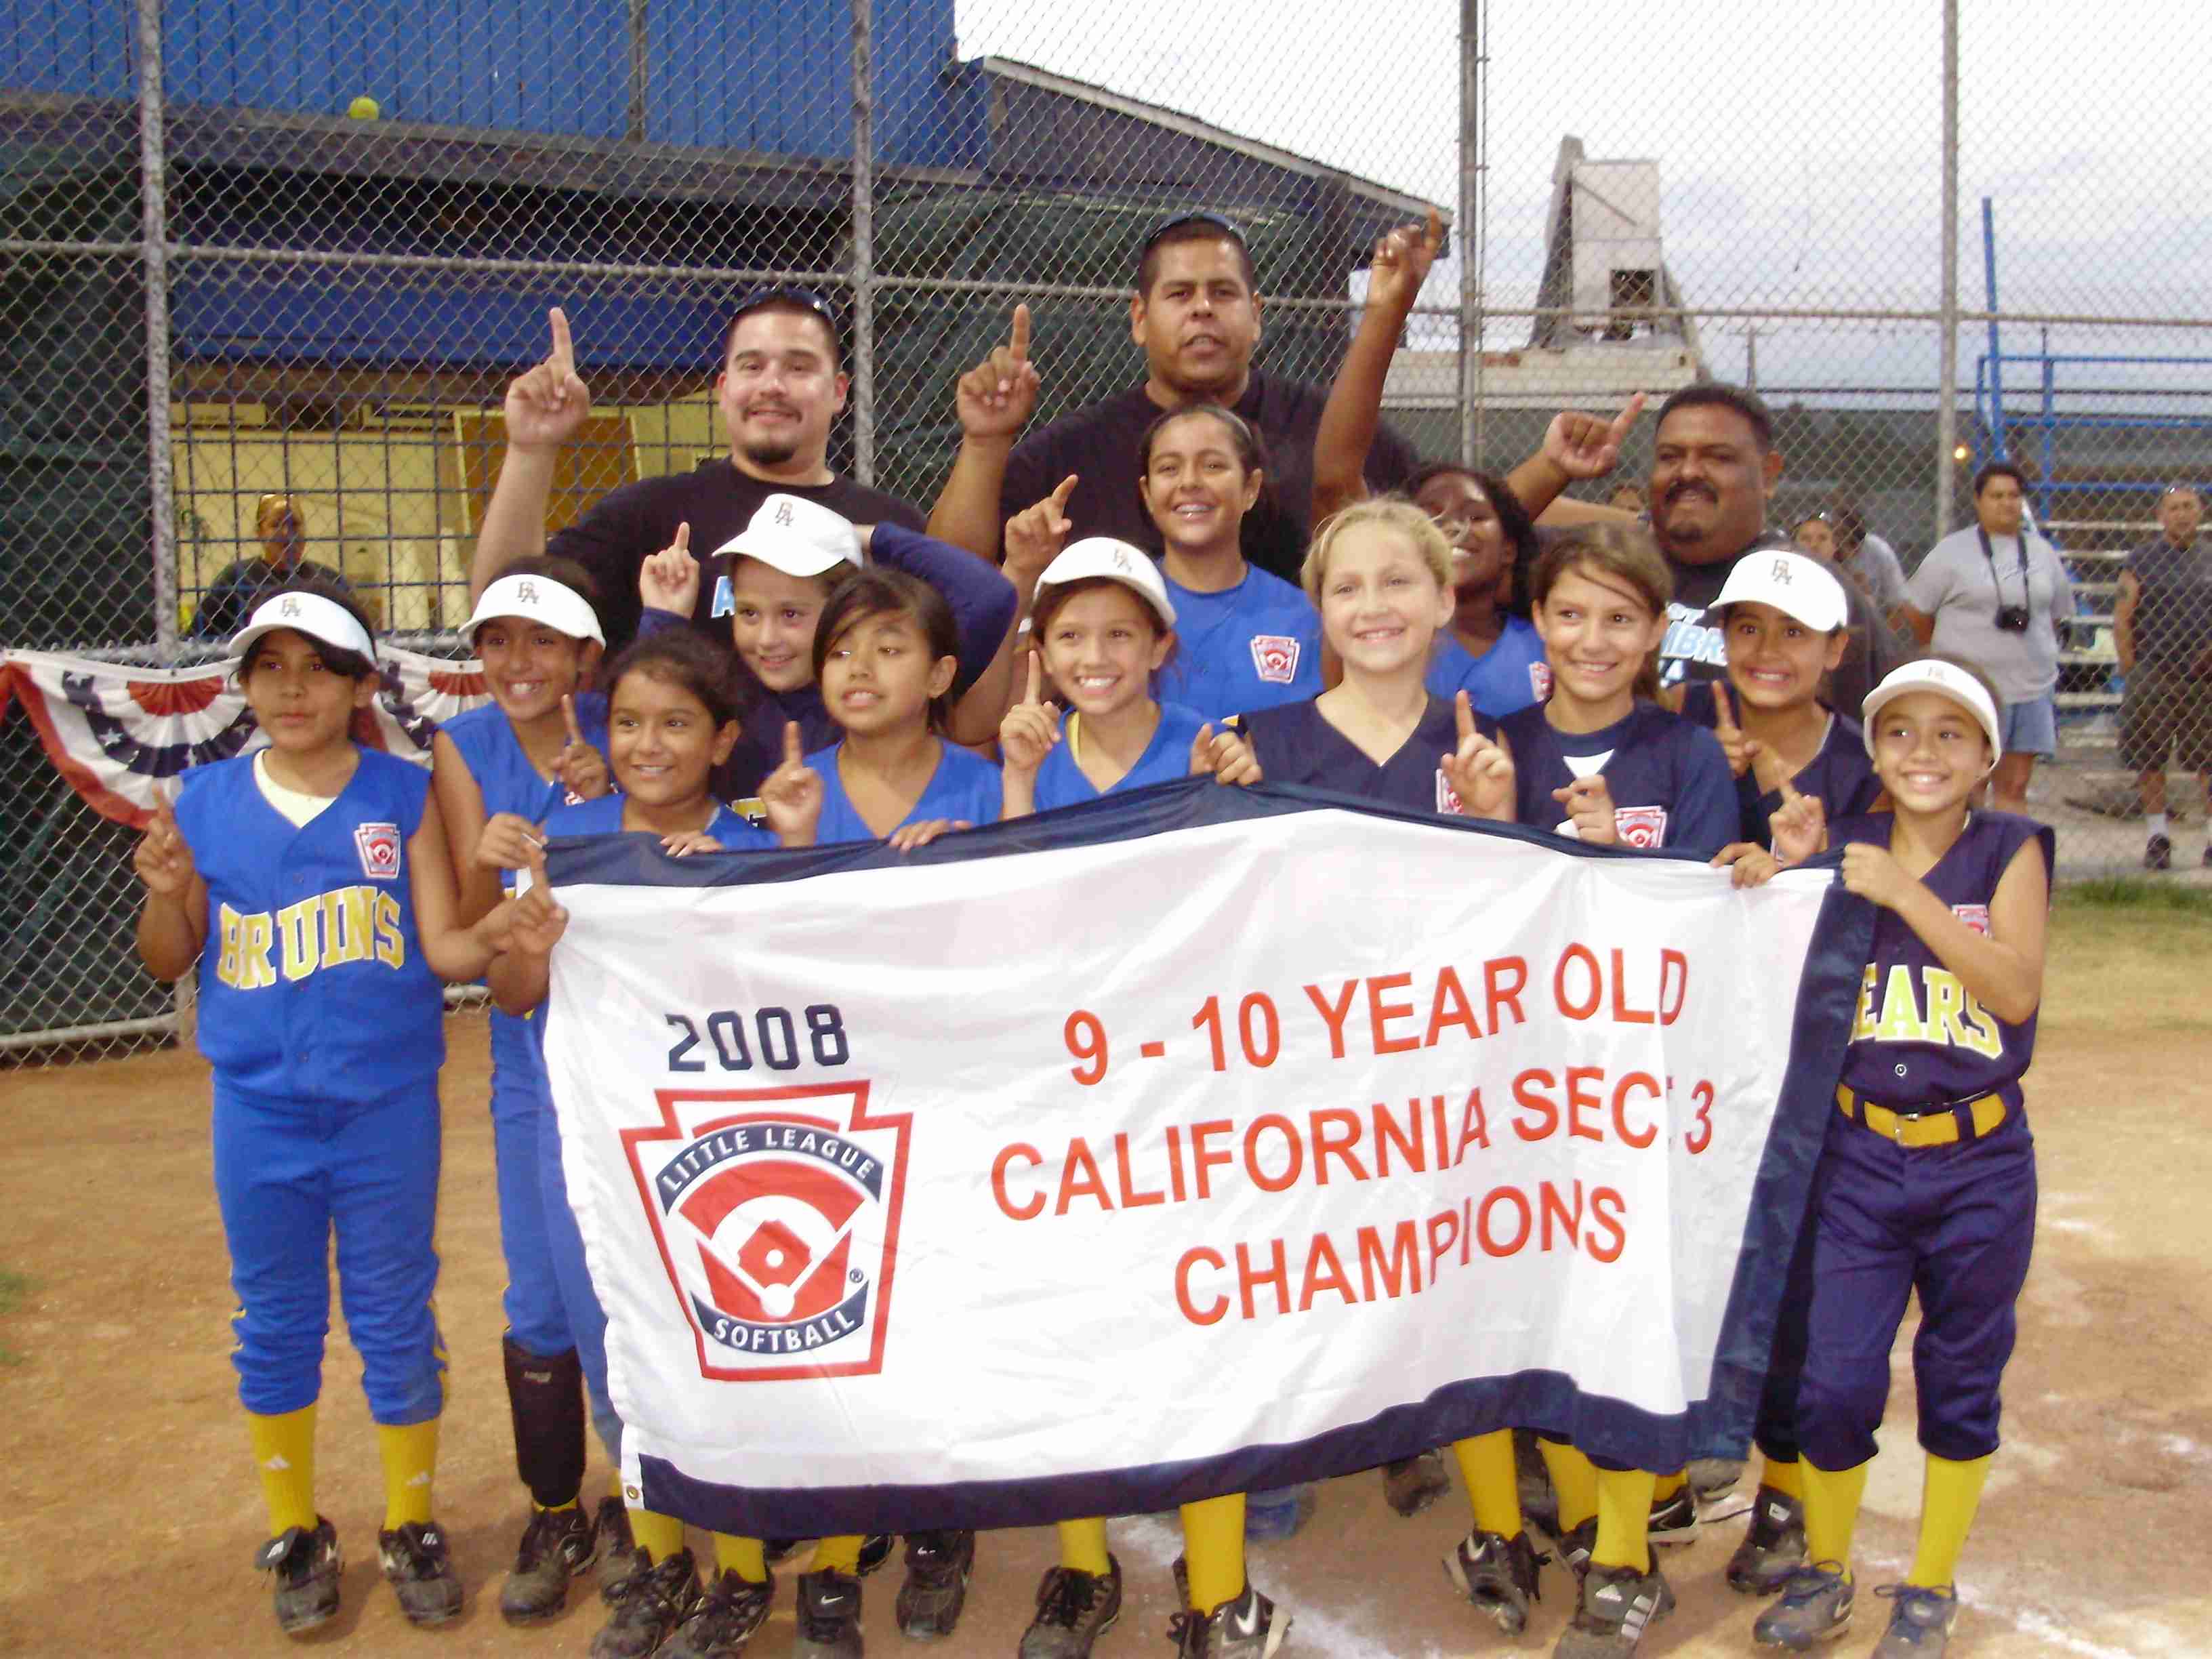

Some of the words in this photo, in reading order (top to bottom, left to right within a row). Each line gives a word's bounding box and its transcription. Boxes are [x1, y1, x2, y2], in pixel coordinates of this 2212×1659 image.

[216, 885, 405, 990] BRUINS
[664, 1004, 850, 1073] 2008
[1063, 1009, 1109, 1086] 9
[1191, 994, 1281, 1073] 10
[1303, 956, 1529, 1059] YEAR
[1553, 942, 1689, 1027] OLD
[1848, 961, 2004, 1060] EARS
[661, 1130, 750, 1192] LITTLE
[764, 1126, 876, 1181] LEAGUE
[990, 1086, 1492, 1222] CALIFORNIA
[1684, 1079, 1715, 1155] 3
[1174, 1179, 1627, 1327] CHAMPIONS
[713, 1309, 856, 1351] SOFTBALL
